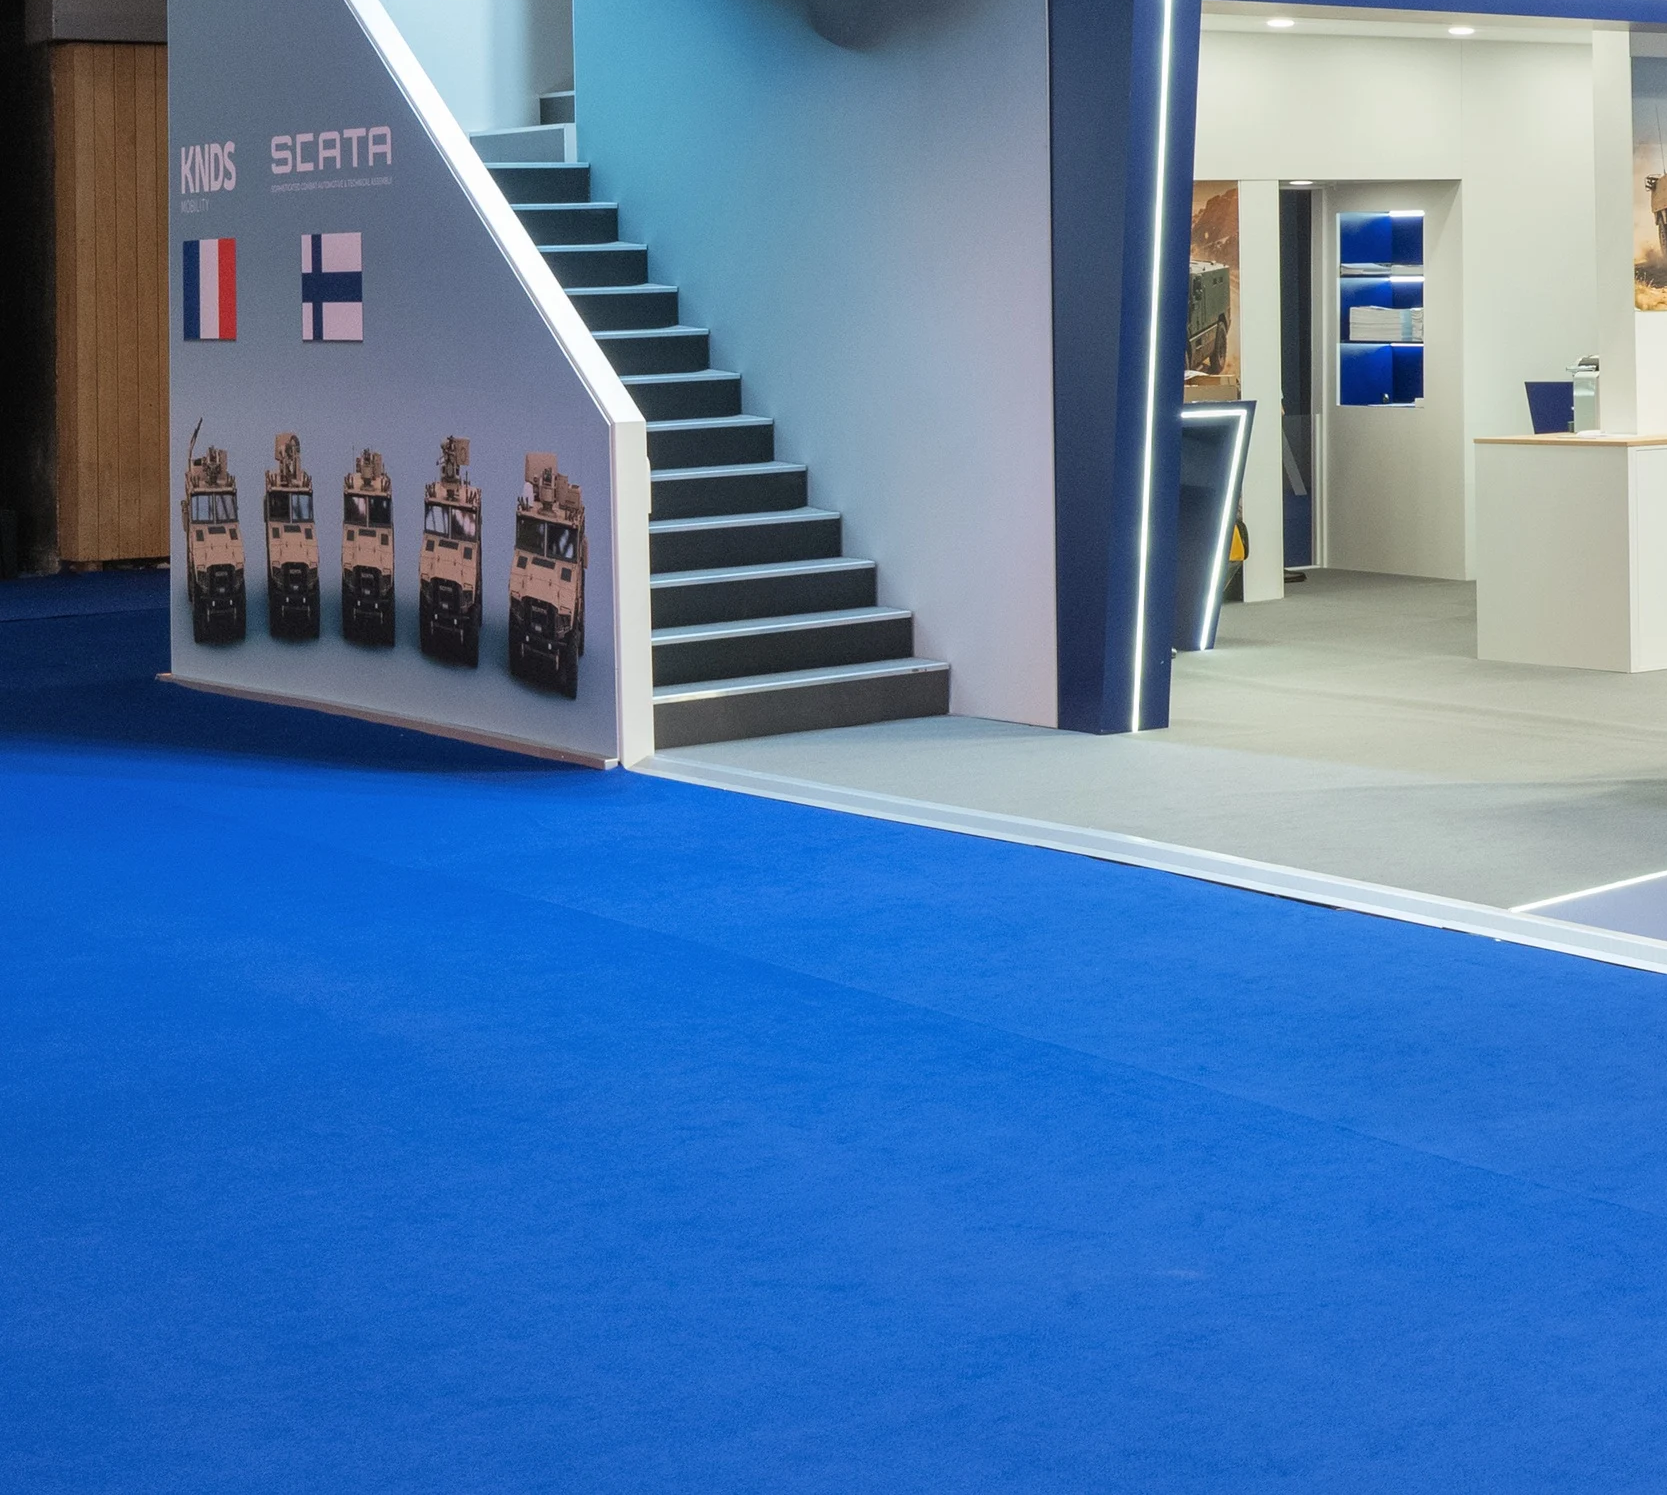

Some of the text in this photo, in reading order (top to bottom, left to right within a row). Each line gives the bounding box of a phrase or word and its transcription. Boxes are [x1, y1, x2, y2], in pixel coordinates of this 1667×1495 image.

[180, 140, 237, 195] KNDS
[271, 126, 392, 174] SCATA
[180, 198, 209, 214] MOBILITY
